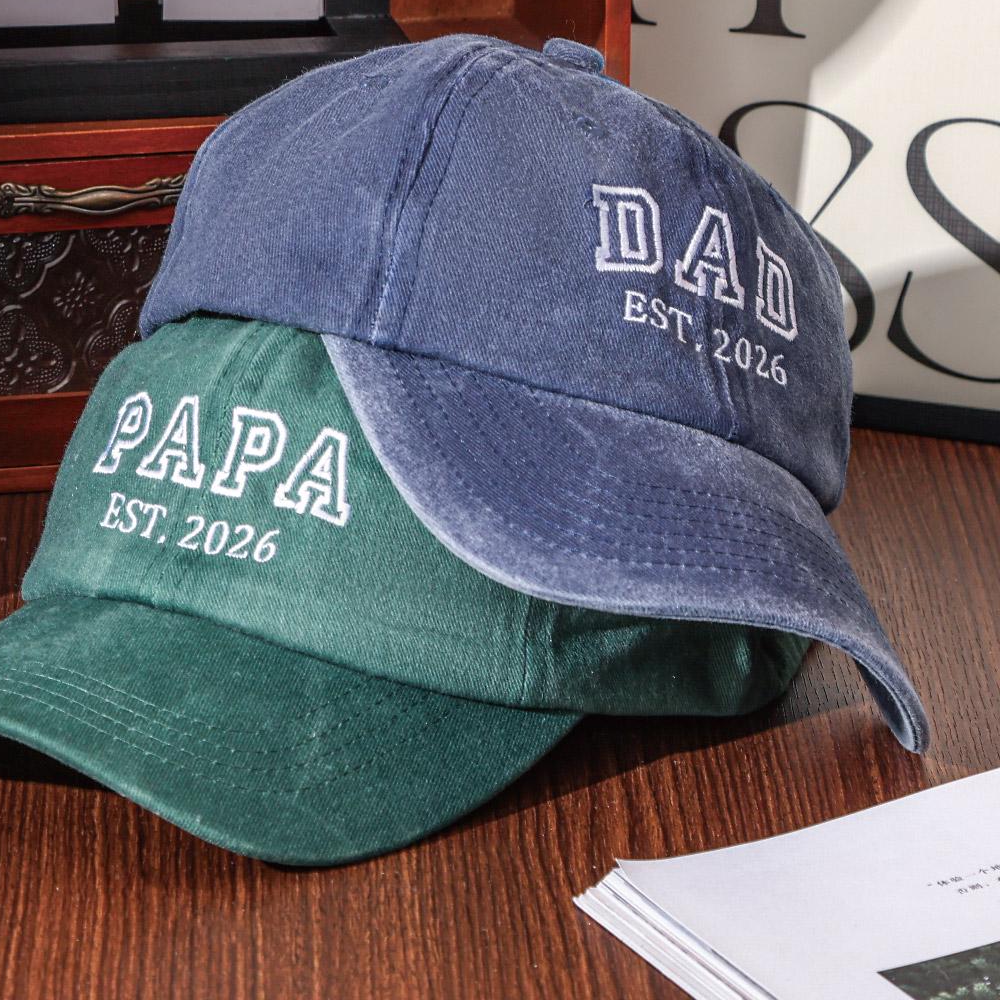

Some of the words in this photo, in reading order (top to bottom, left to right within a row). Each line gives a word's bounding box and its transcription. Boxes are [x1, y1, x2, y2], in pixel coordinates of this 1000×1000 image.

[592, 183, 798, 342] DAD
[623, 290, 703, 353] EST.
[712, 328, 788, 387] 2026
[92, 392, 351, 527] PAPA
[100, 492, 167, 544] EST.
[177, 515, 280, 563] 2026
